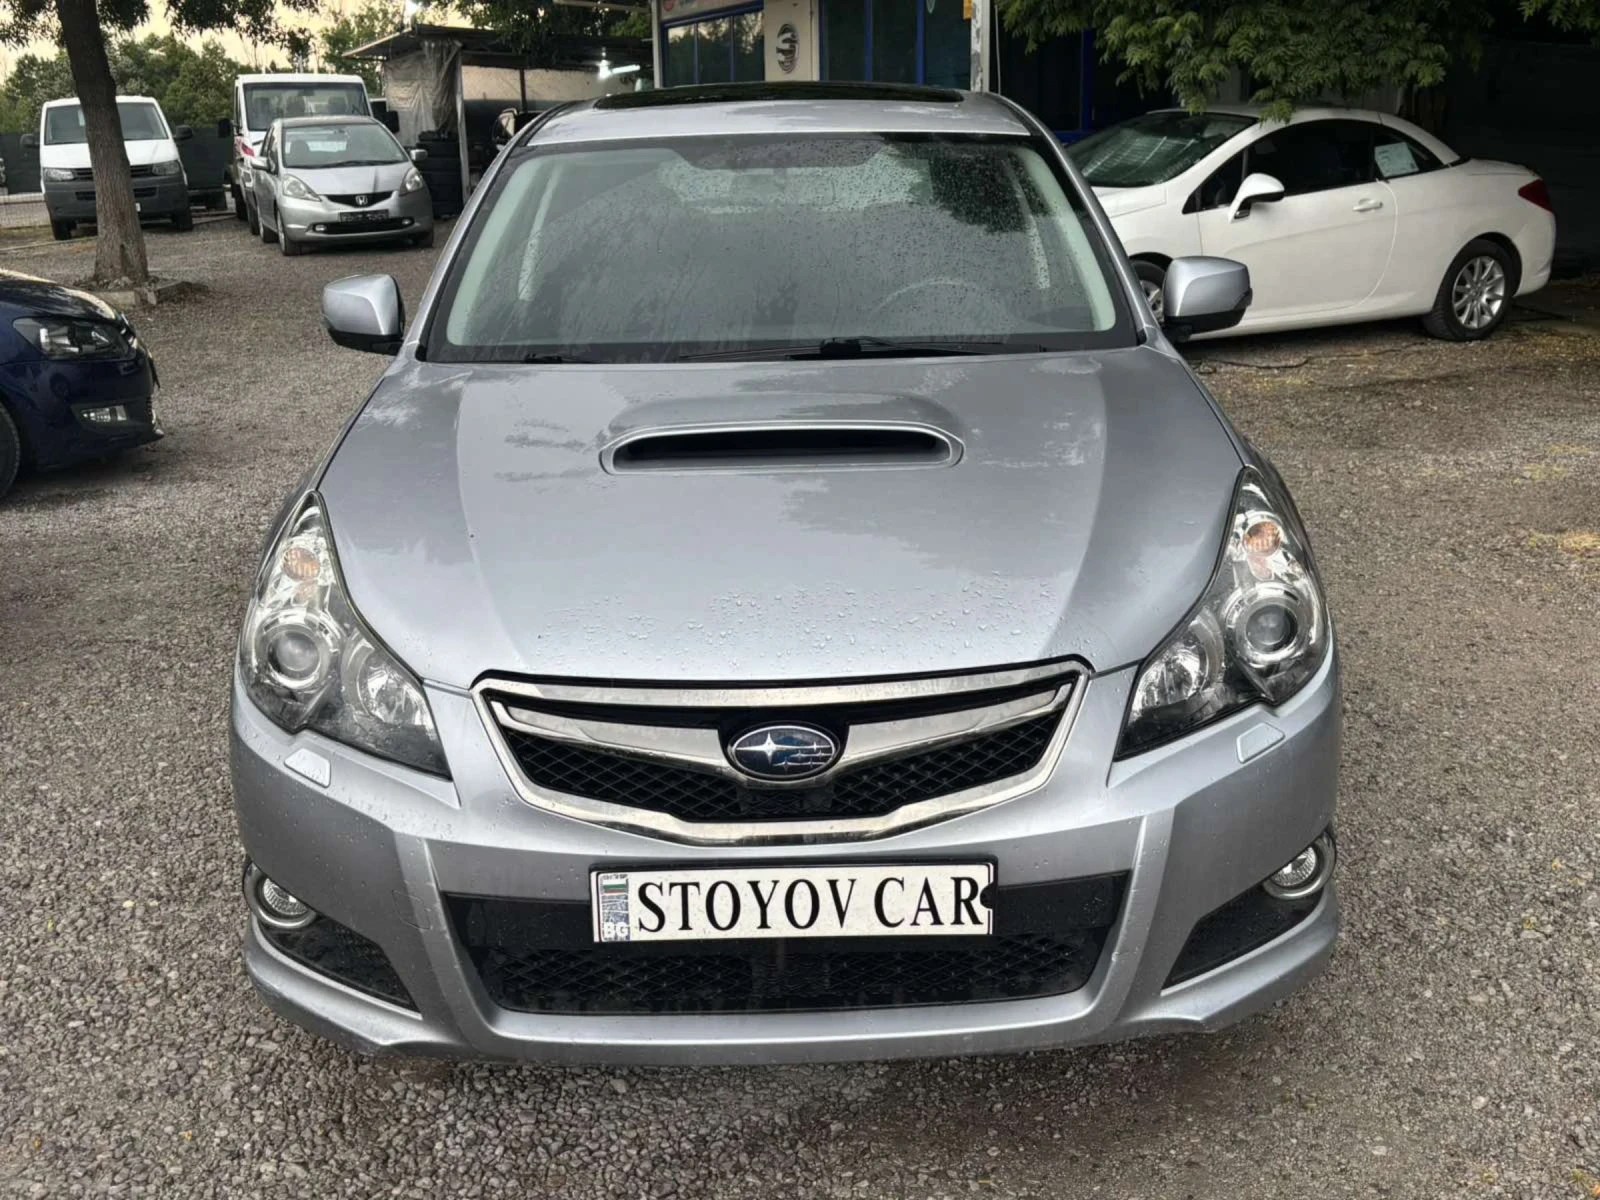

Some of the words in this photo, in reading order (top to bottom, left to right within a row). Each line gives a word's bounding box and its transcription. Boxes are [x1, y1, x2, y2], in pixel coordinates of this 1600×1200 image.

[638, 879, 855, 932] STOYOV
[874, 877, 983, 928] CAR
[603, 922, 629, 938] BG
